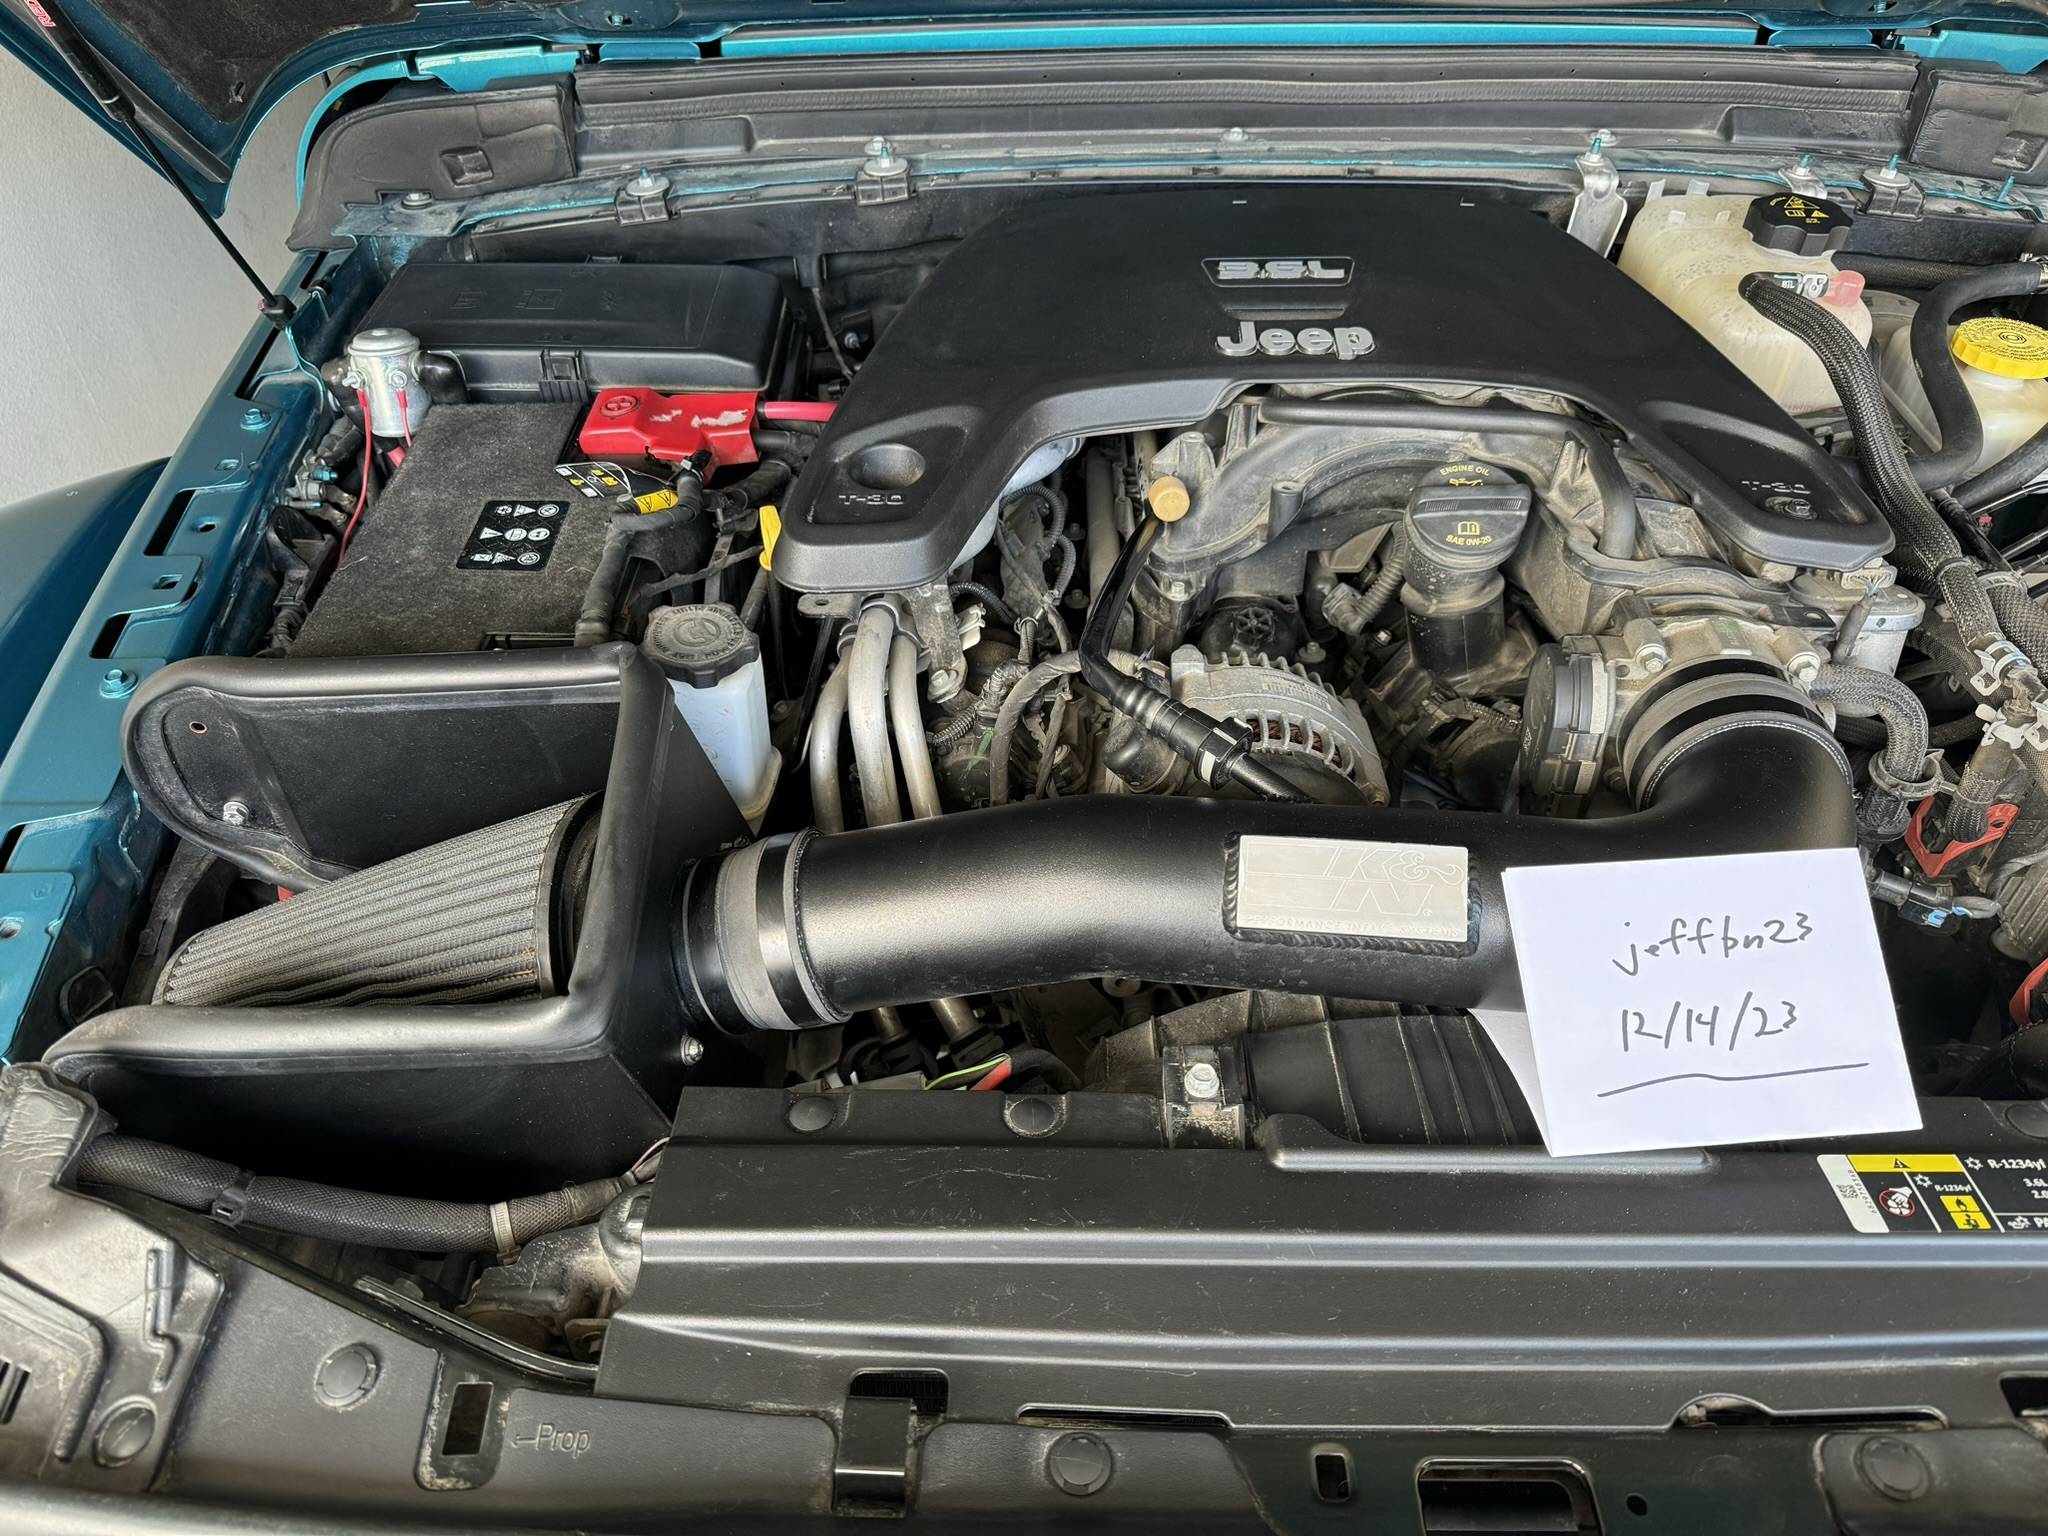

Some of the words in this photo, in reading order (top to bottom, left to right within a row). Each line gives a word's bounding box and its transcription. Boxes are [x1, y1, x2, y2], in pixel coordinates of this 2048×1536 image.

[1217, 260, 1345, 279] 3.6L
[1215, 321, 1376, 360] Jeep
[1439, 465, 1474, 476] ENGINE
[1475, 466, 1489, 476] OIL
[838, 494, 904, 505] T-30
[1445, 534, 1465, 546] SAE
[1622, 991, 1798, 1053] 12/14/23
[1987, 1158, 2047, 1170] R-1234yf
[1934, 1184, 1973, 1193] R-1234yf
[535, 1422, 591, 1460] Prop
